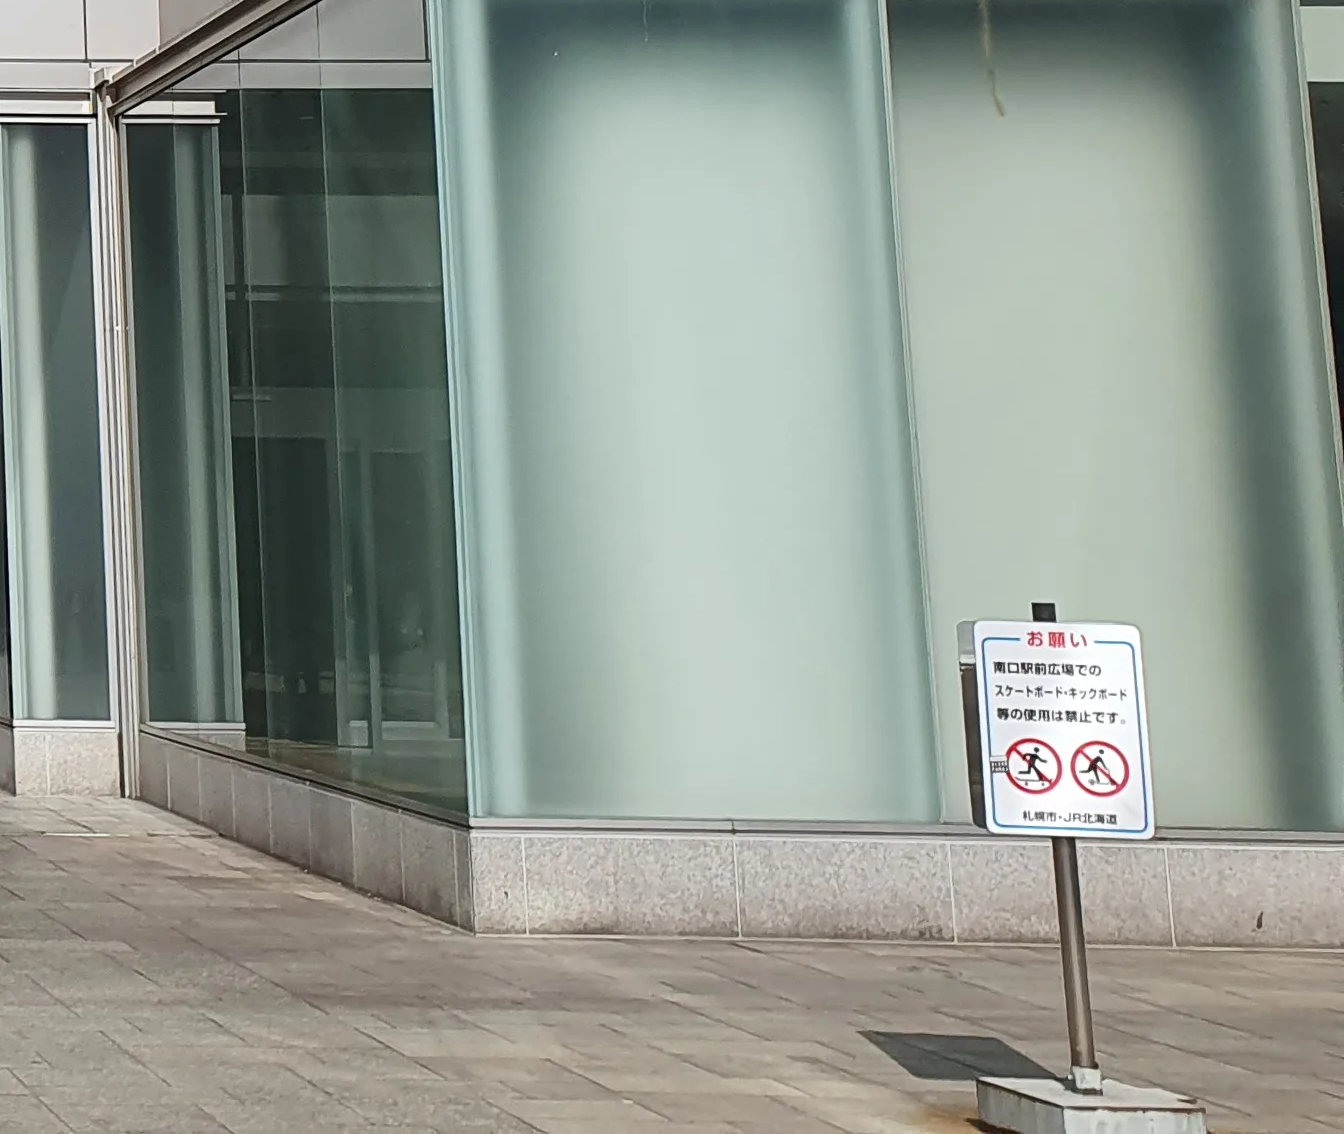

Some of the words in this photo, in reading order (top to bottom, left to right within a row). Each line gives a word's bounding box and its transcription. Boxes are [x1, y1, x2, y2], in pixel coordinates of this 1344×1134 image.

[1026, 631, 1088, 648] お願い
[993, 661, 1102, 677] 南口駅前広場での
[996, 707, 1127, 725] 等の使用は禁止です。
